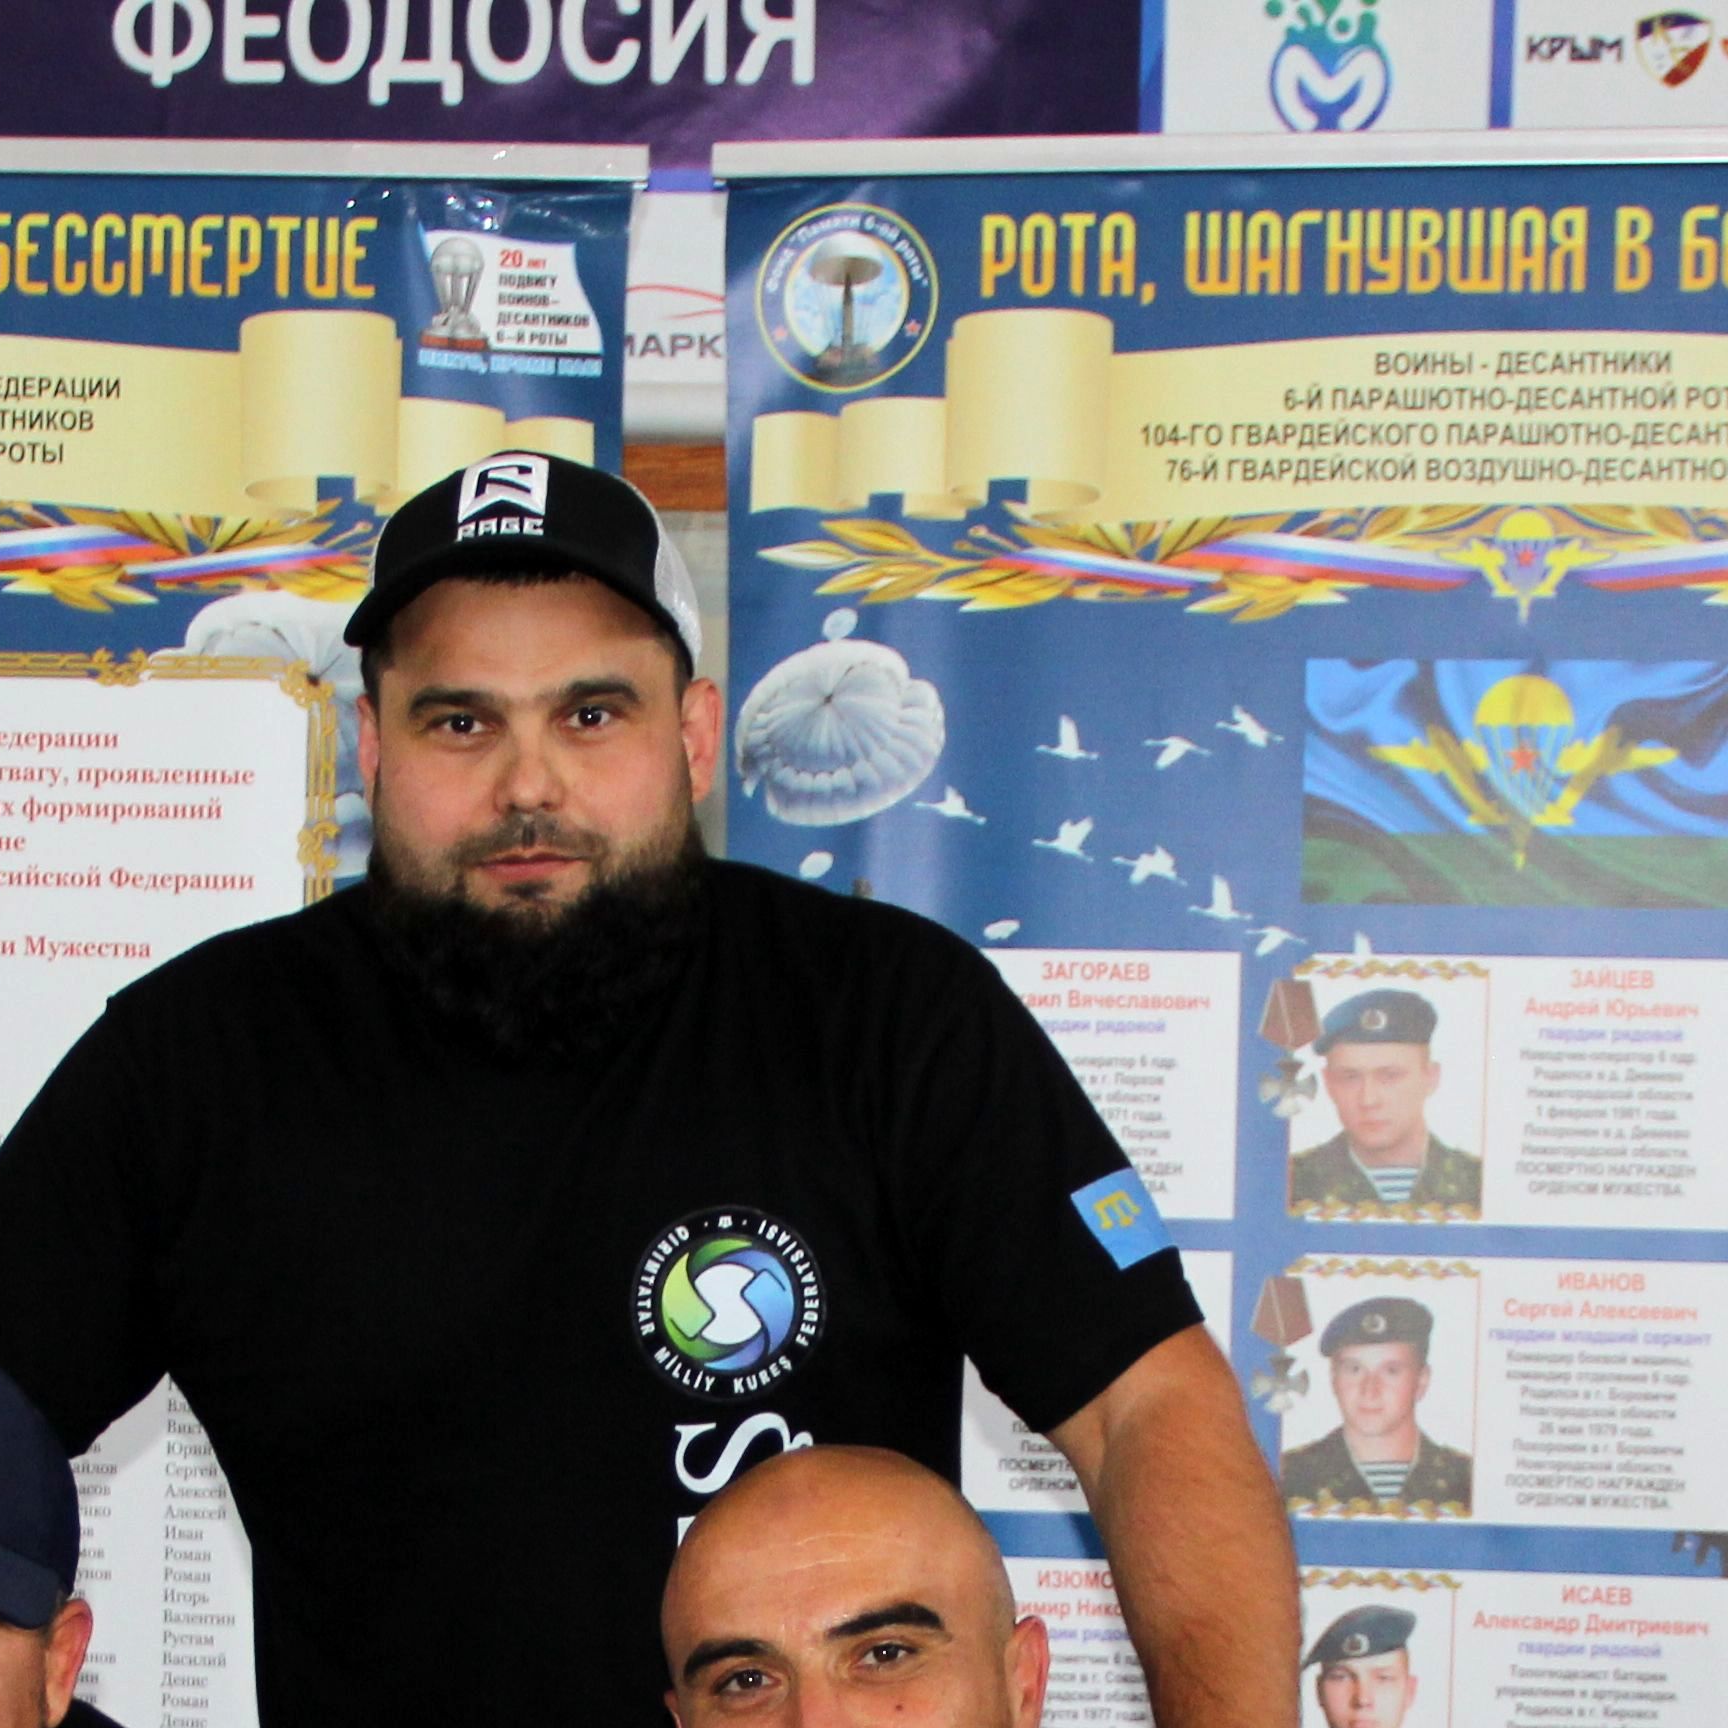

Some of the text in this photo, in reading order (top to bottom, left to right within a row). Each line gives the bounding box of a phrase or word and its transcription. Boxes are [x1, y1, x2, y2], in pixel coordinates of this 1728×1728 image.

[111, 0, 817, 106] ФЕОДОСИЯ
[1526, 34, 1623, 63] КРЫМ
[500, 249, 523, 268] 20
[980, 211, 1157, 305] РОТА,
[1184, 205, 1589, 296] ШАГНУВШАЯ
[1614, 205, 1654, 293] В
[1374, 350, 1672, 379] ВОИНЫ ДЕСАНТНИКИ
[1283, 383, 1323, 412] 6-Й
[1331, 386, 1677, 414] ПАРАШЮТНО-ДЕСАНТНОЙ
[1140, 422, 1224, 448] 104-ГО
[1231, 418, 1439, 450] ГВАРДЕЙСКОГО
[1166, 454, 1219, 483] 76-Й
[1226, 457, 1417, 486] ГВАРДЕЙСКОЙ
[77, 767, 255, 789] проявленные
[21, 796, 222, 824] формирований
[108, 867, 254, 896] Федерации
[24, 936, 151, 959] Мужества
